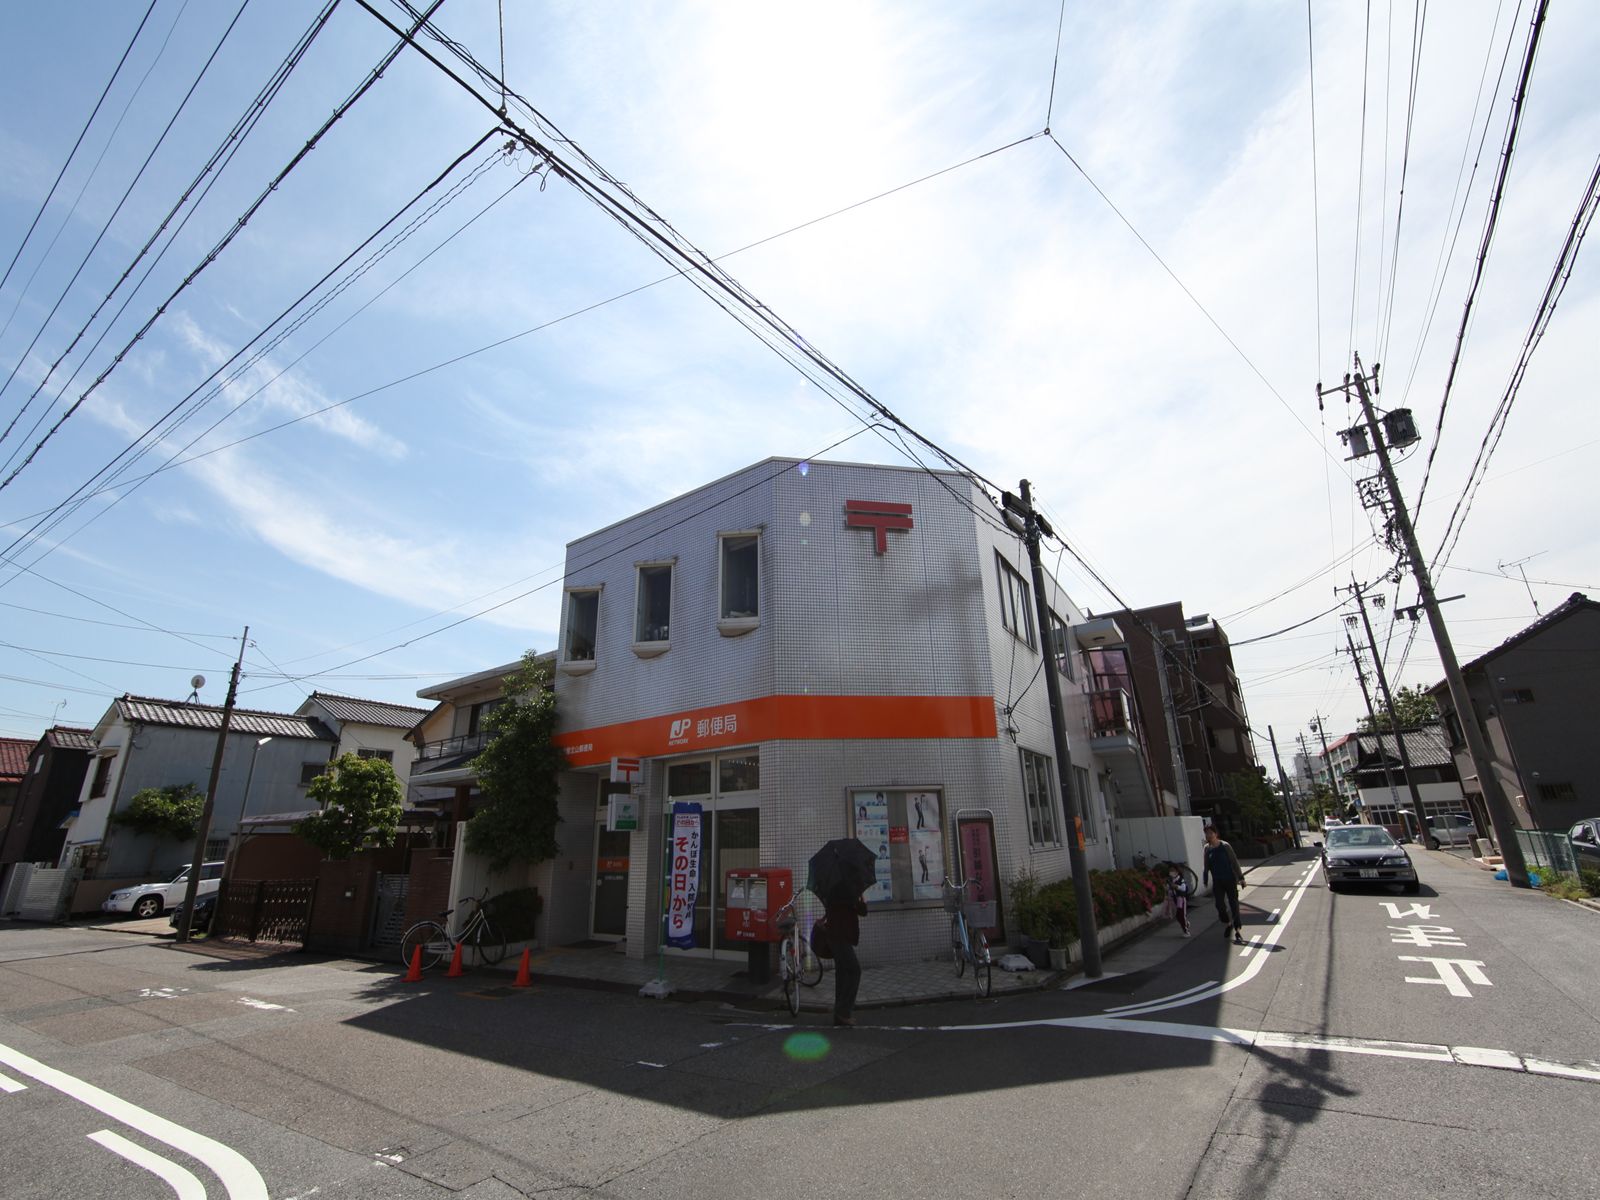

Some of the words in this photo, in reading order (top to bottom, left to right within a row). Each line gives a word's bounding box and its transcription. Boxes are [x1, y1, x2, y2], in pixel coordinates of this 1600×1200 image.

[696, 714, 737, 738] 郵便局
[672, 836, 689, 929] その日から
[1379, 901, 1494, 998] 止まれ
